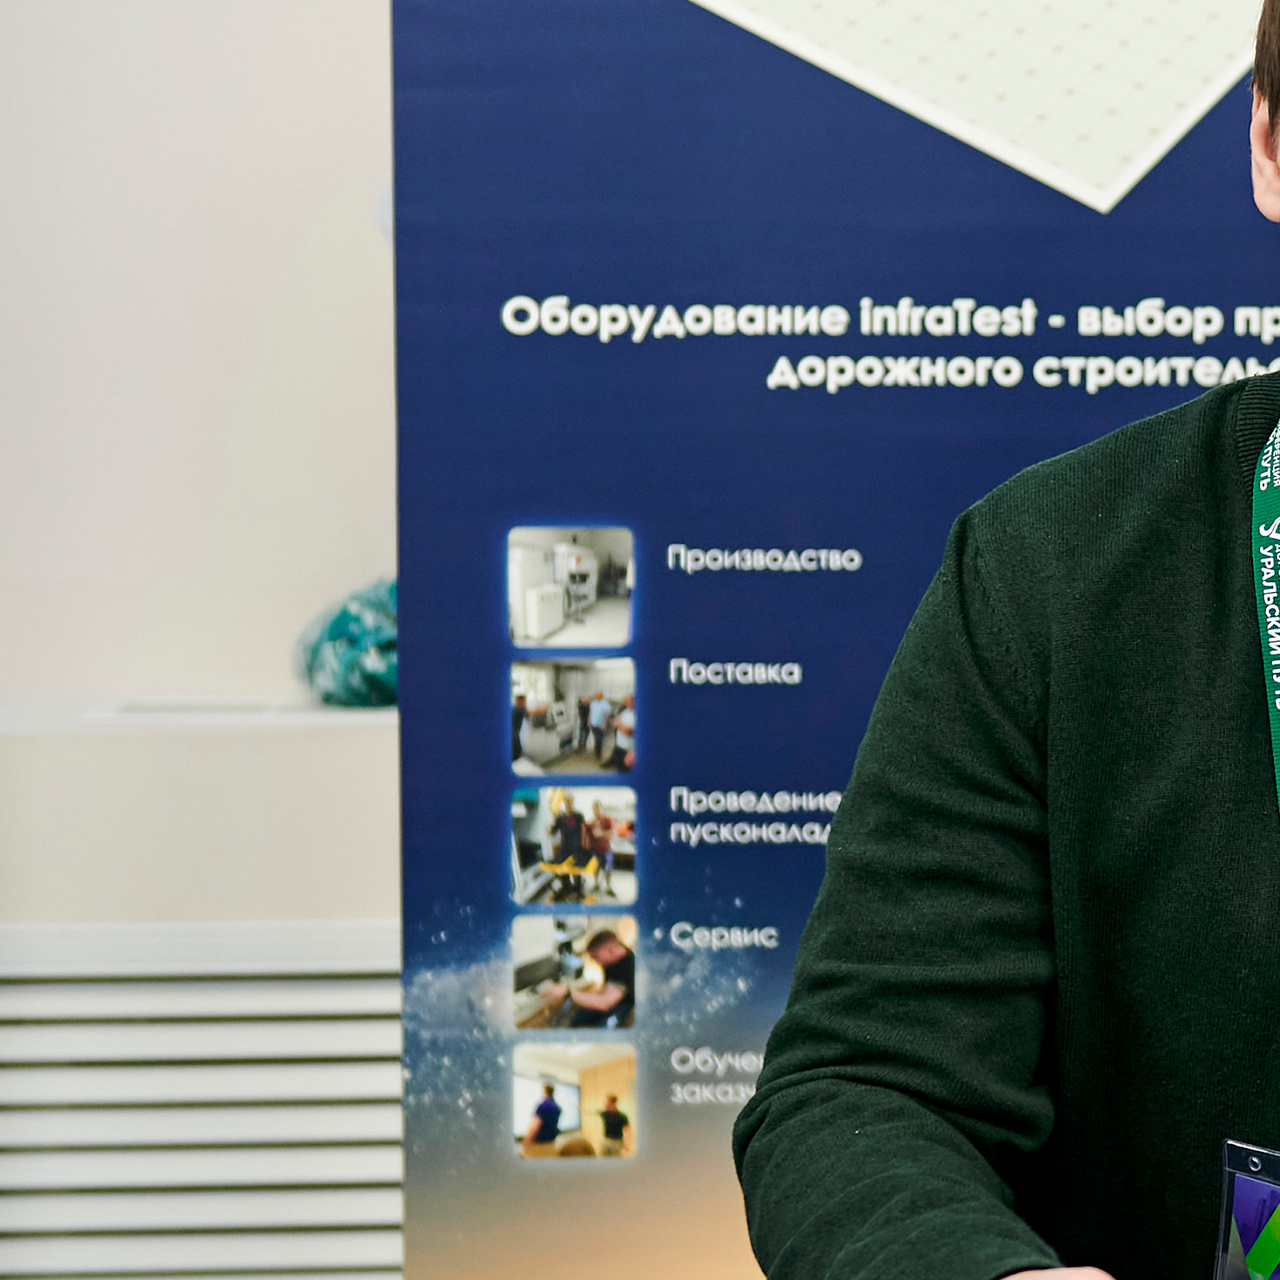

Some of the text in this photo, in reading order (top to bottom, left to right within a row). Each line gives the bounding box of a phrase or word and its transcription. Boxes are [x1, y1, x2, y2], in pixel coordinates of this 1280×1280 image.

[501, 295, 851, 344] Оборудование
[859, 296, 1038, 337] infraTest
[1077, 297, 1225, 345] выбор
[766, 355, 1024, 395] дорожного
[667, 543, 864, 576] Производство
[669, 657, 803, 685] Поставка
[670, 786, 843, 817] Проведение
[669, 921, 779, 952] Сервис
